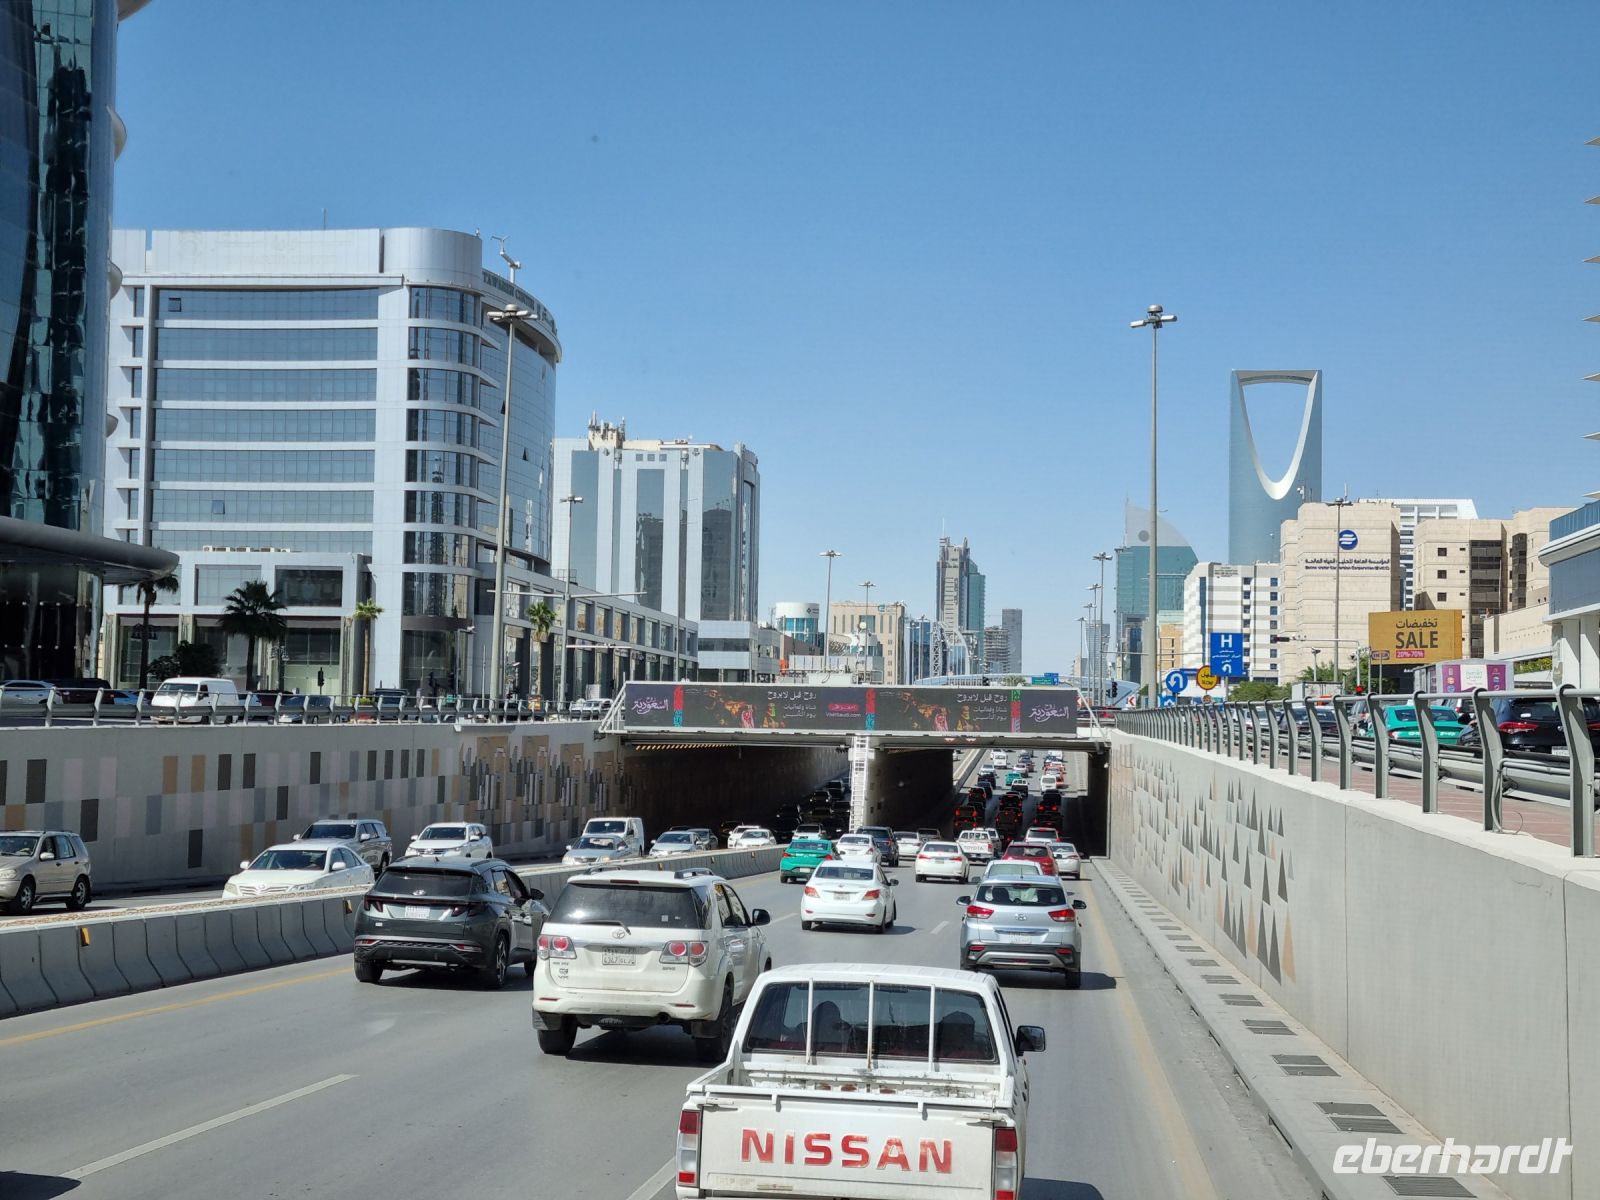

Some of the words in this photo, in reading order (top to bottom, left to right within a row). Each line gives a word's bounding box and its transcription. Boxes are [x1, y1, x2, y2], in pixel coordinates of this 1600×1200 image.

[1395, 618, 1438, 630] تخفيضات
[1220, 634, 1233, 648] H
[1395, 631, 1439, 649] SALE
[789, 690, 802, 701] قبل
[803, 690, 817, 701] روح
[980, 693, 993, 704] قبل
[993, 694, 1008, 704] روح
[741, 1127, 953, 1174] NISSAN
